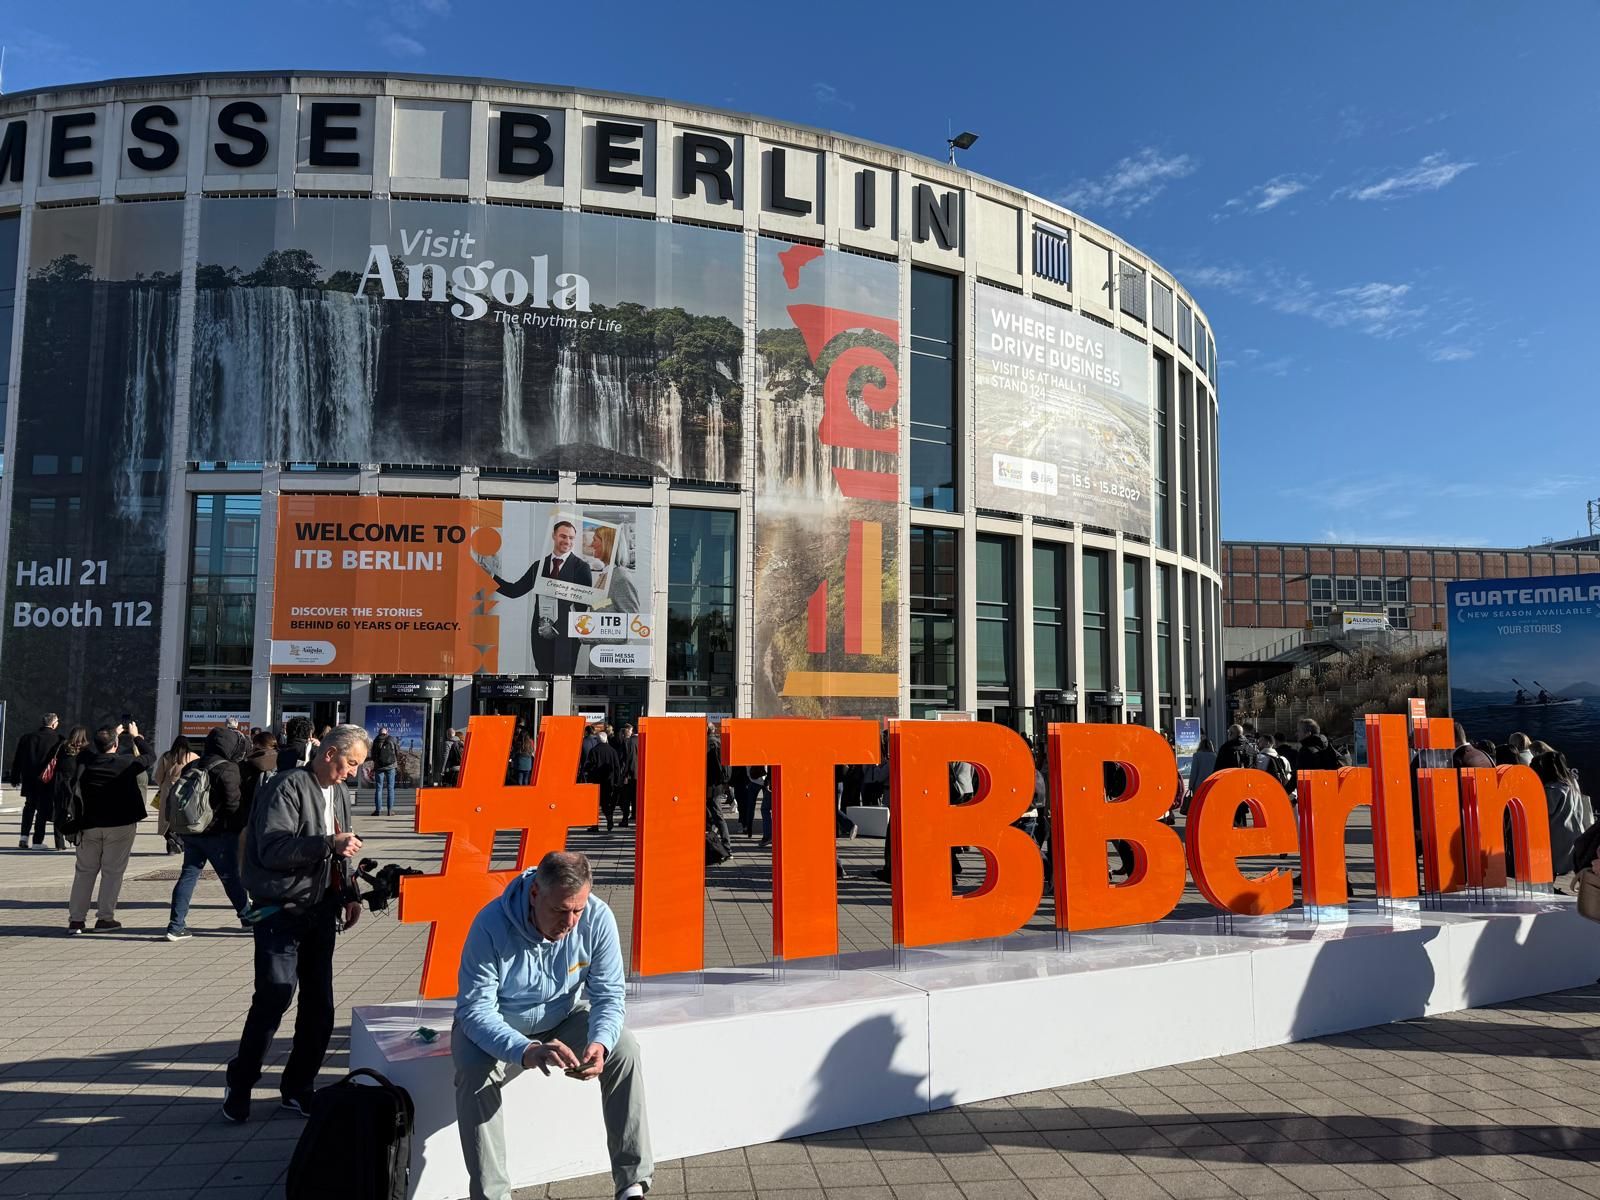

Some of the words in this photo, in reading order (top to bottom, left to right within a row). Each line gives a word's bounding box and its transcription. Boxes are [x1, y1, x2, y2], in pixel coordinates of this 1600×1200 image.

[498, 111, 958, 249] BERLIN
[400, 228, 476, 259] Visit
[354, 244, 593, 321] Angola
[494, 310, 519, 324] The
[523, 312, 577, 329] Rhythm
[581, 316, 596, 330] of
[598, 318, 622, 333] Life
[991, 308, 1056, 344] WHERE
[1060, 329, 1104, 360] IDEAS
[991, 333, 1045, 363] DRIVE
[1050, 349, 1121, 387] BUSINESS
[992, 360, 1020, 377] VISIT
[1022, 367, 1035, 380] US
[1037, 371, 1050, 385] AT
[1051, 375, 1077, 393] HALL
[992, 374, 1028, 394] STAND
[295, 522, 425, 543] WELCOME
[433, 525, 466, 544] TO
[294, 549, 333, 569] ITB
[342, 550, 443, 571] BERLIN!
[16, 558, 72, 586] Hall
[79, 559, 109, 586] 21
[1455, 585, 1600, 607] GUATEMALA
[13, 599, 103, 627] Booth
[111, 600, 153, 627] 112
[291, 607, 348, 617] DISCOVER
[351, 607, 373, 617] THE
[376, 607, 423, 618] STORIES
[600, 616, 621, 627] ITB
[1467, 611, 1489, 619] NEW
[1493, 609, 1532, 618] SEASON
[1536, 607, 1593, 616] AVAILABLE
[290, 620, 334, 630] BEHIND
[336, 620, 351, 630] 60
[353, 621, 392, 631] YEARS
[394, 621, 411, 631] OF
[413, 622, 461, 632] LEGACY.
[1497, 625, 1521, 635] YOUR
[1523, 624, 1562, 633] STORIES
